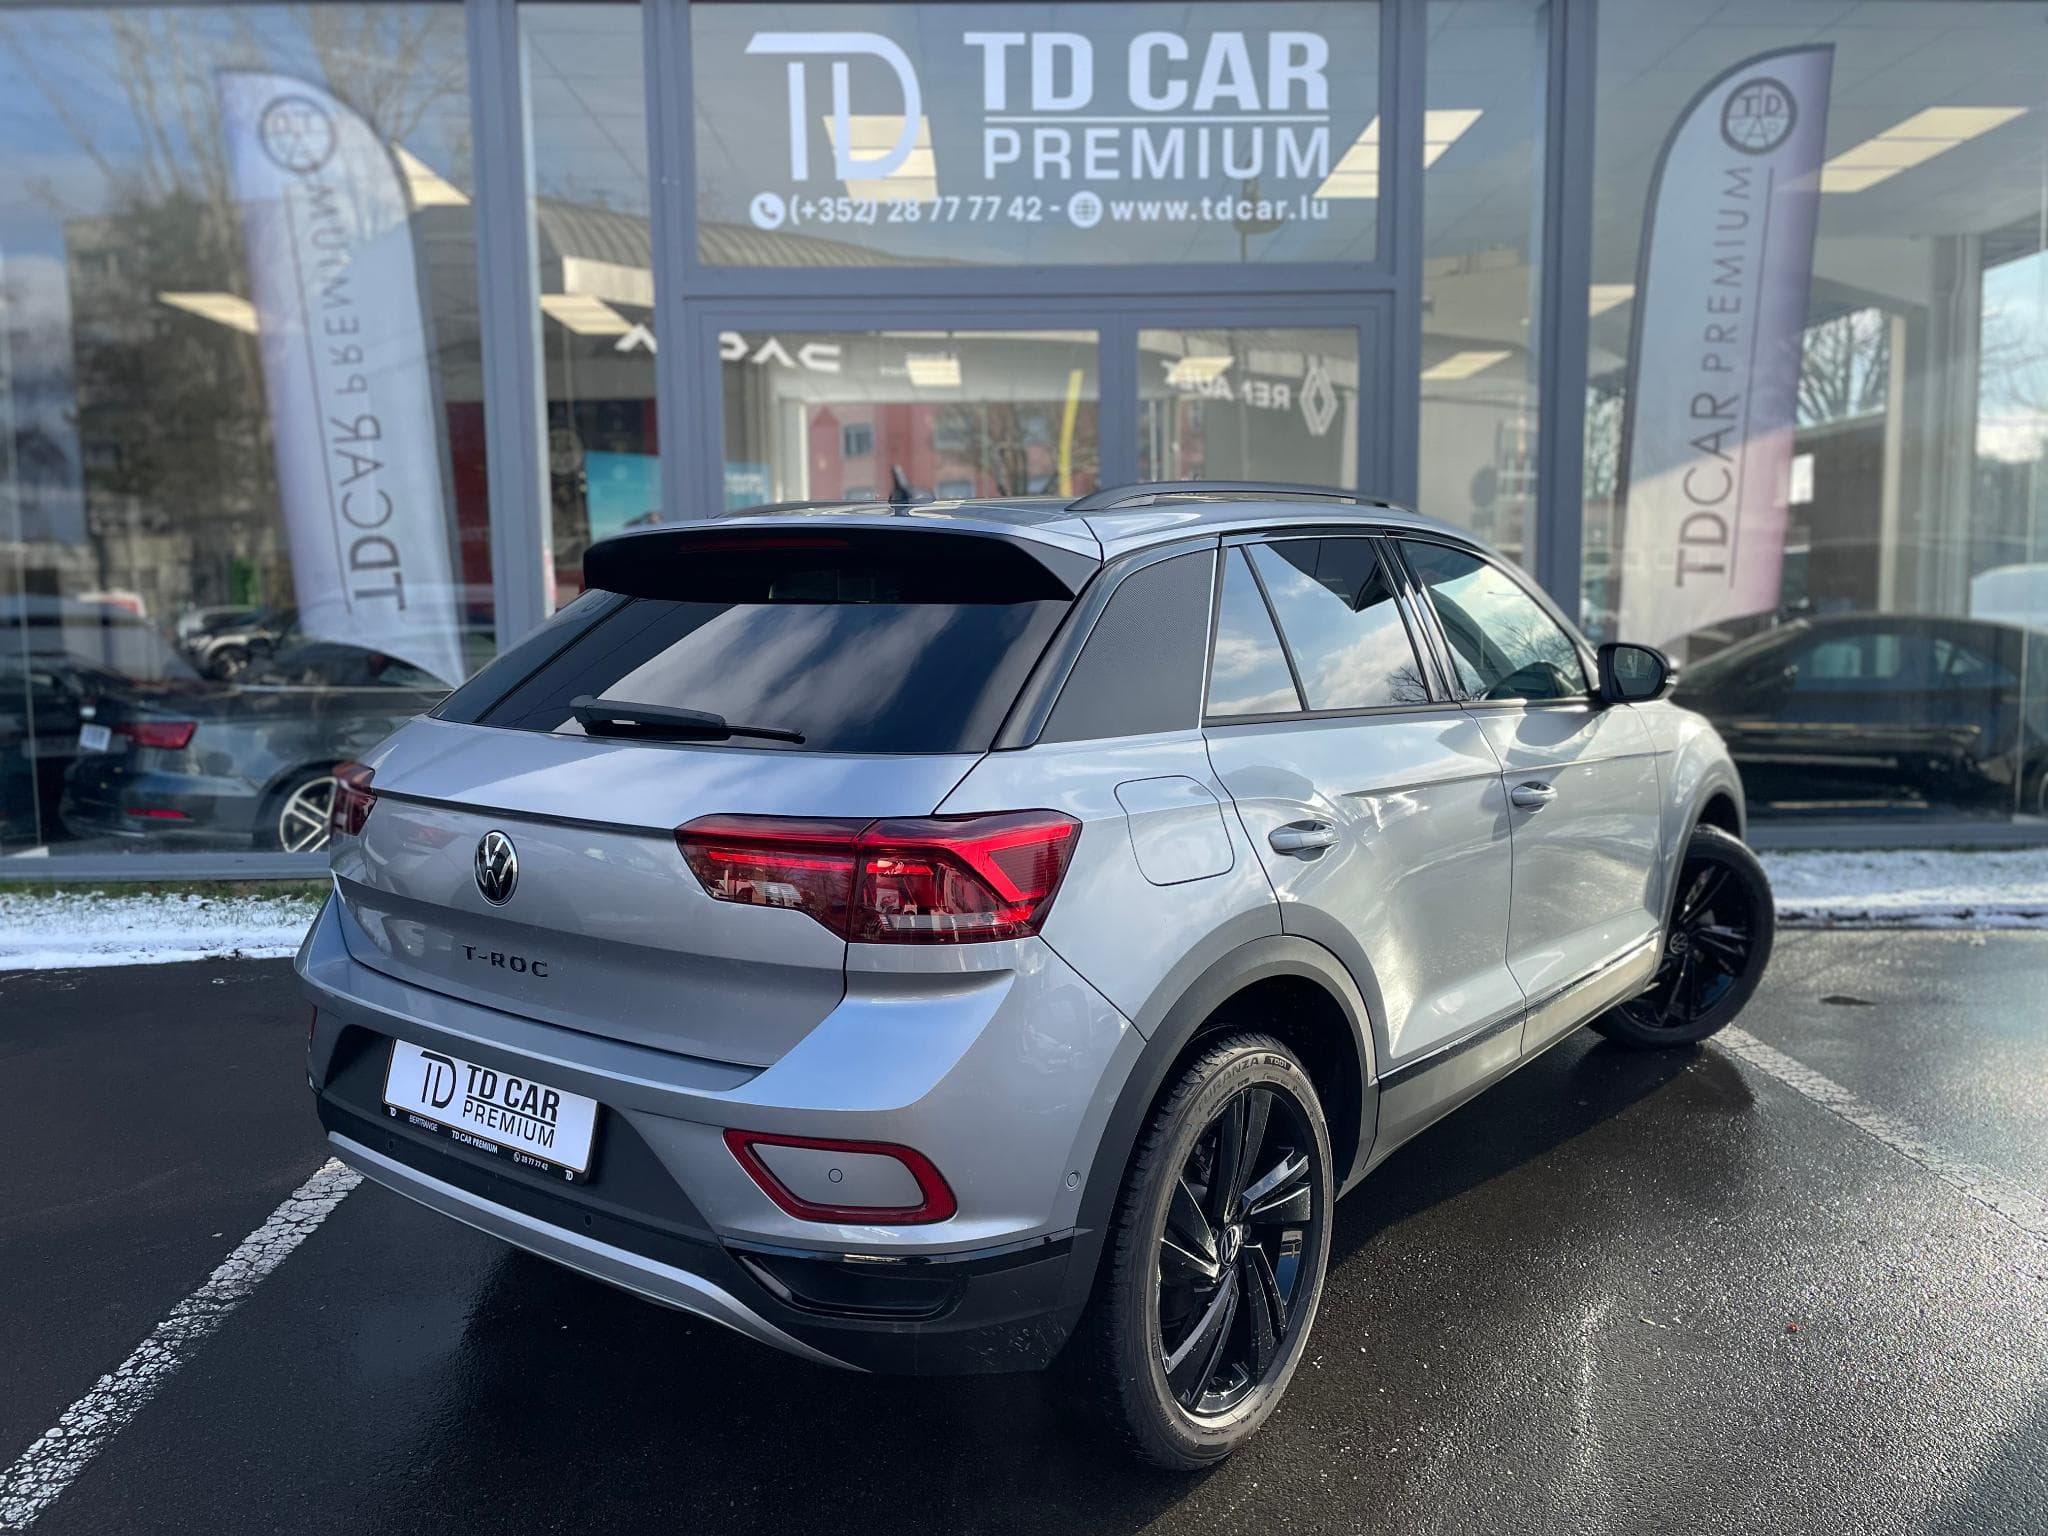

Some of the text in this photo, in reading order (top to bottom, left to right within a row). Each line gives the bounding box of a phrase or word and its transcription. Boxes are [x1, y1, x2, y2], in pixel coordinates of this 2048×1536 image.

[963, 31, 1329, 111] TD CAR
[984, 126, 1330, 180] PREMIUM
[790, 195, 878, 225] (+352)
[887, 197, 922, 223] 28
[931, 197, 961, 223] 77
[969, 197, 1001, 222] 77
[1007, 196, 1043, 222] 42
[1110, 196, 1329, 222] www.tdcar.lu
[1675, 165, 1753, 588] TDCAR PREMIUM
[462, 943, 549, 978] T-ROC
[466, 1064, 560, 1122] TD CAR
[409, 1114, 438, 1132] BERTRANGE
[452, 1130, 498, 1154] TD CAR PREMIUM
[463, 1099, 556, 1149] PREMIUM
